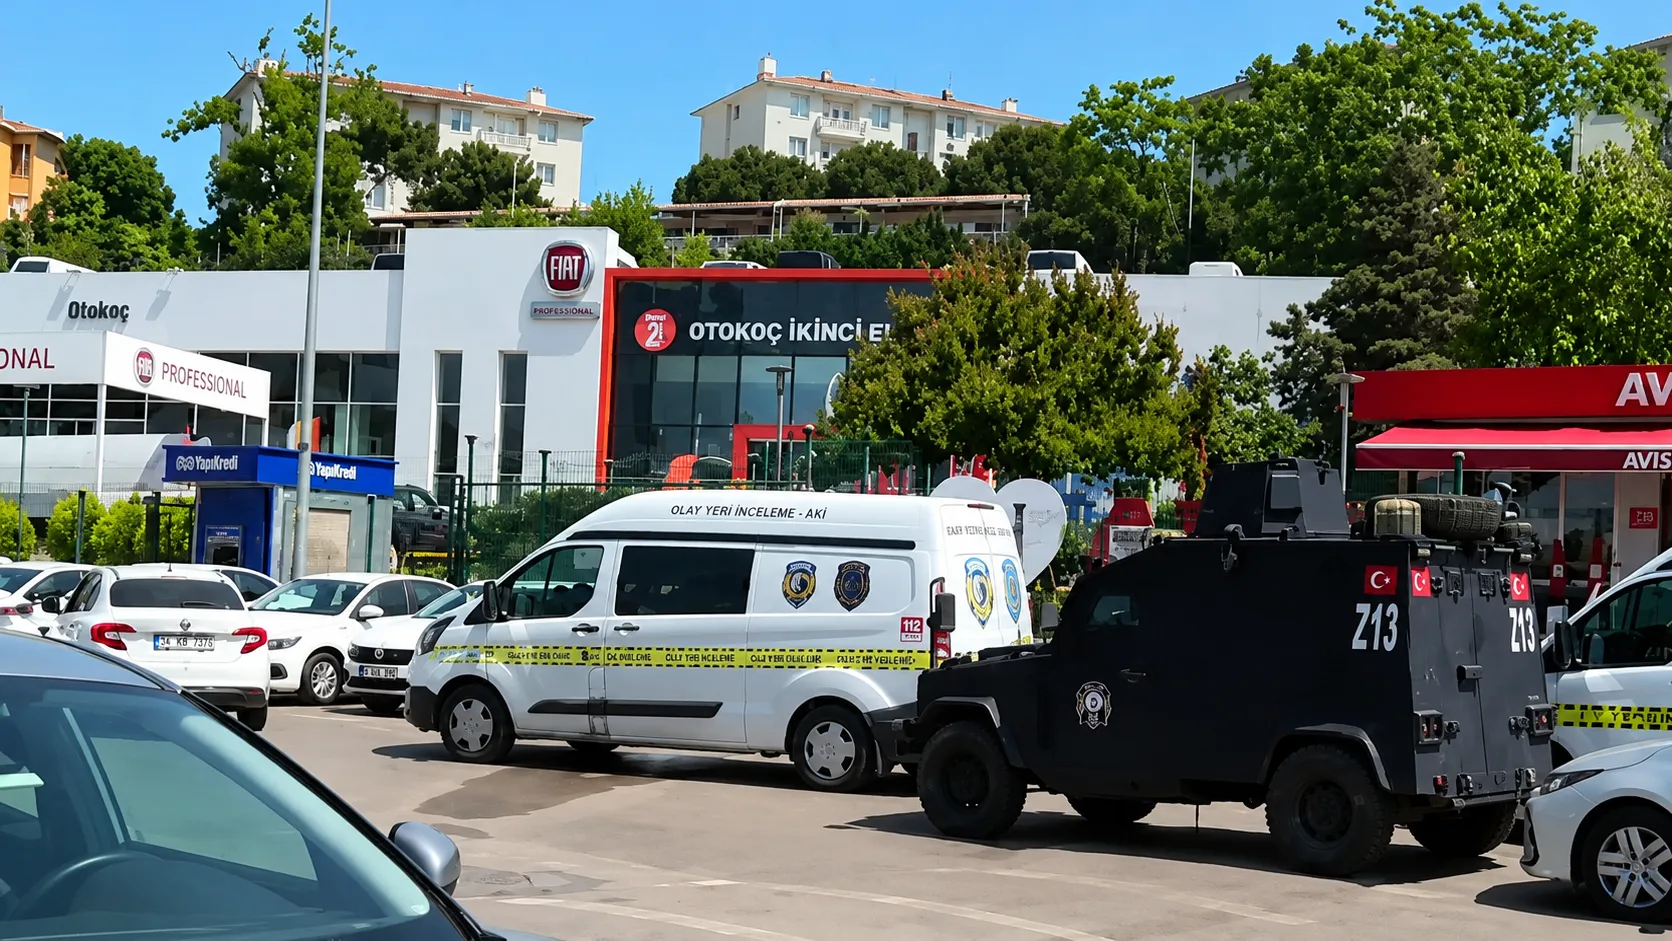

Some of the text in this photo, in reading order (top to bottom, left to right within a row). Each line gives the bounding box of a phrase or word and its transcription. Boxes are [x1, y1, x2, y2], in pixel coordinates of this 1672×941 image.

[550, 255, 582, 280] FIAT
[68, 300, 130, 323] Otokoç
[533, 307, 594, 315] PROFESSIONAL
[689, 322, 783, 345] OTOKOÇ
[789, 317, 862, 342] İKİNCİ
[161, 362, 247, 399] PROFESSIONAL
[1622, 451, 1672, 469] AVIS
[671, 505, 702, 515] OLAY
[705, 504, 733, 516] YERİ
[734, 504, 796, 519] İNCELEME
[805, 507, 827, 520] AKİ
[903, 619, 921, 632] 112
[1352, 602, 1399, 651] Z13
[1509, 607, 1536, 652] Z13
[160, 637, 171, 646] 34
